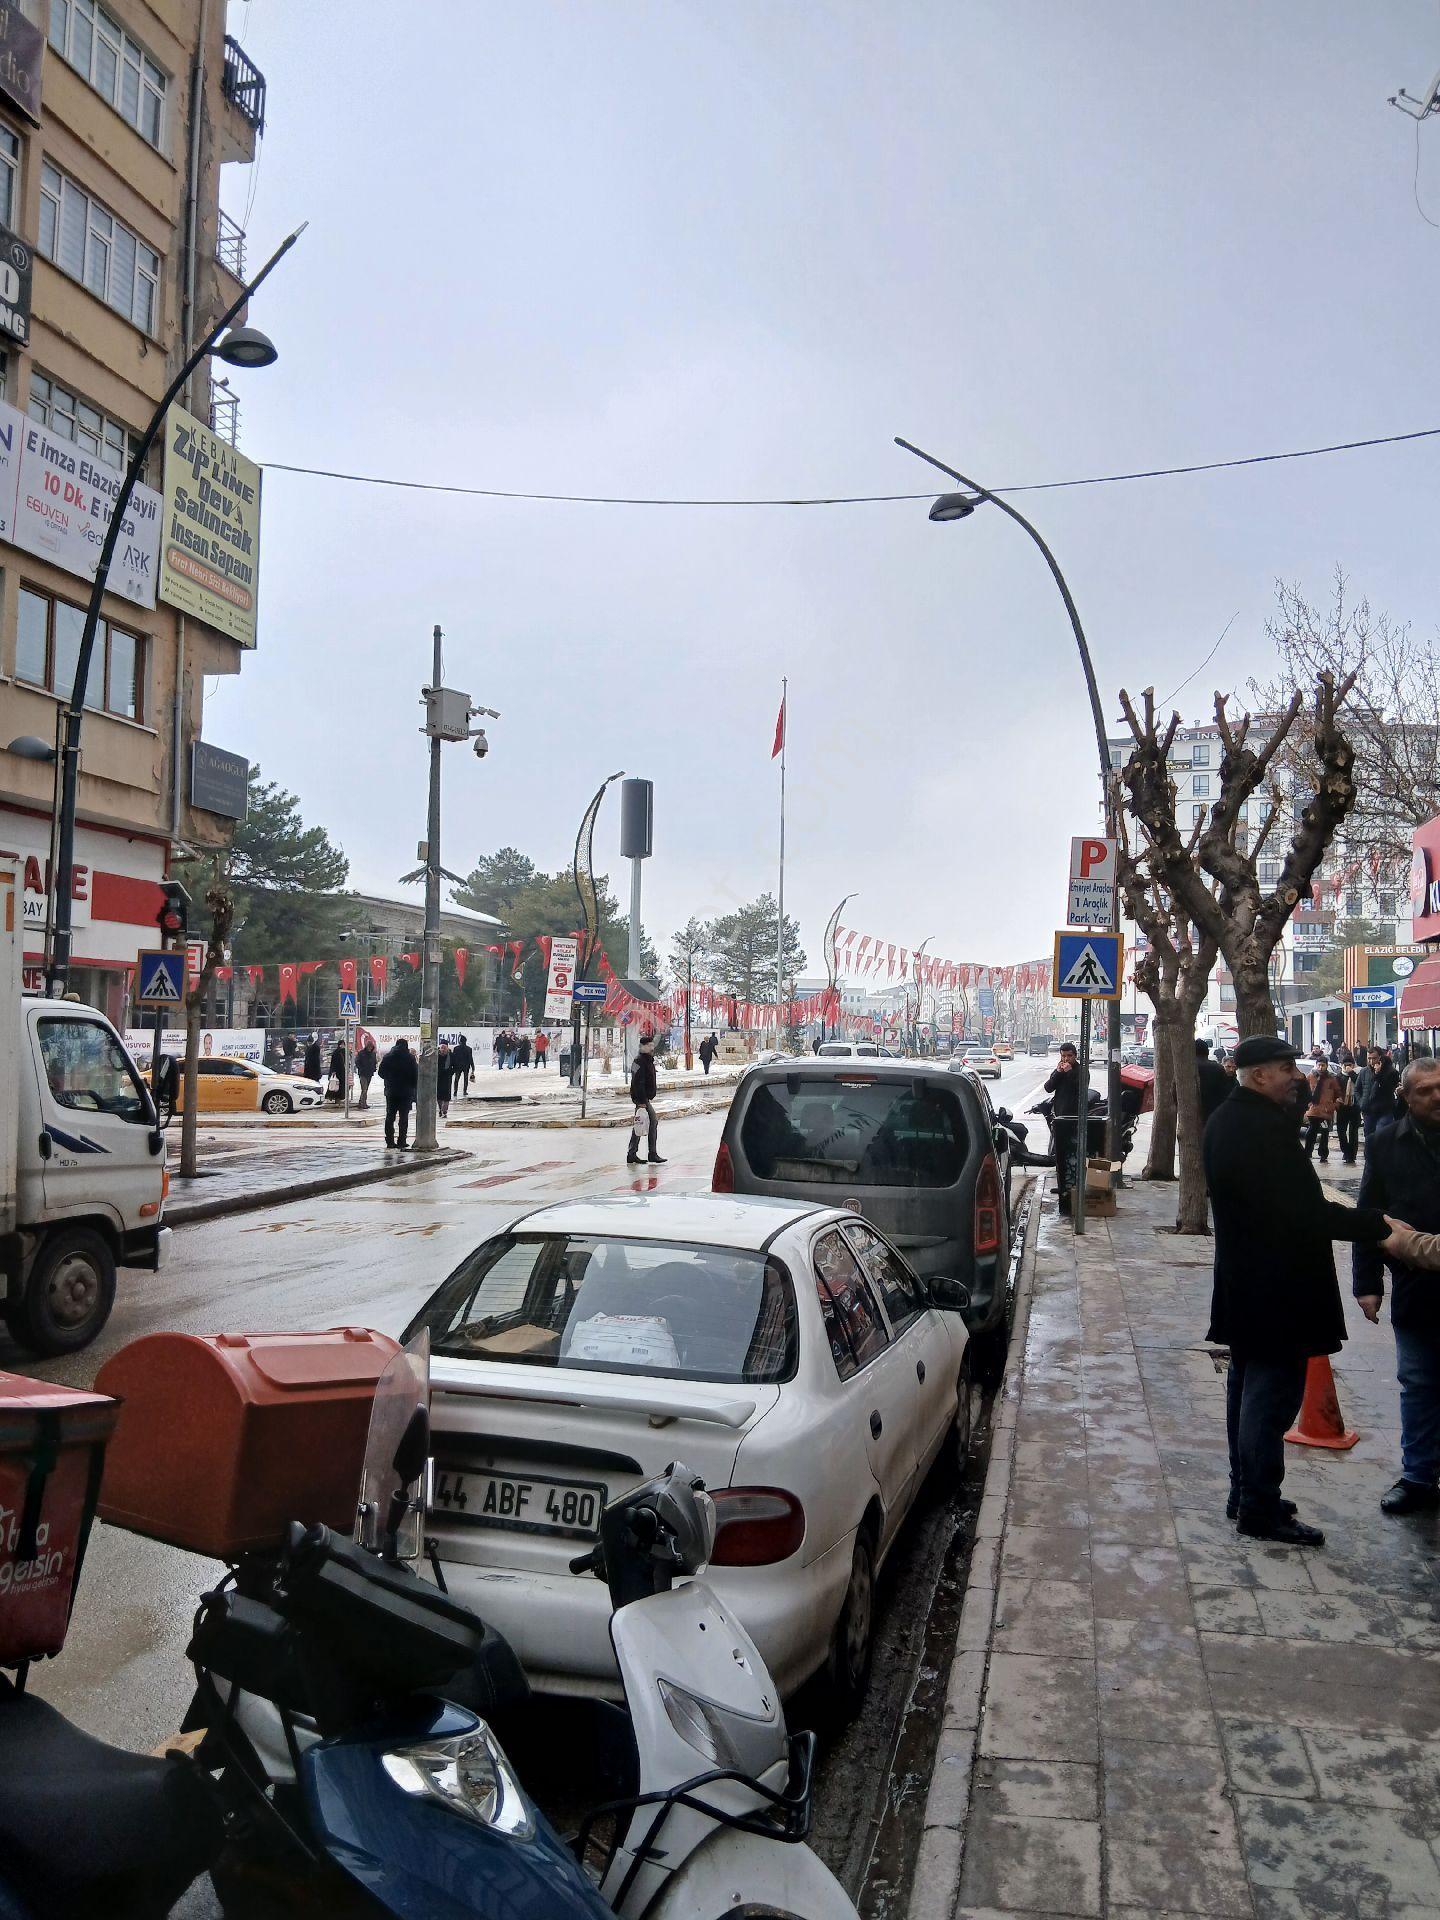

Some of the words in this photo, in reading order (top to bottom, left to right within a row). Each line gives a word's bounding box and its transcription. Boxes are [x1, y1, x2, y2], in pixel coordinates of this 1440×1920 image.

[40, 437, 76, 475] imza
[190, 425, 238, 475] KEBAN
[44, 470, 61, 496] 10
[64, 481, 87, 512] Dk.
[198, 476, 233, 517] Dev
[211, 461, 255, 505] LINE
[1080, 840, 1108, 878] P
[1070, 912, 1090, 923] Park
[1093, 913, 1111, 924] Yeri
[1075, 897, 1080, 907] 1
[1364, 943, 1394, 954] ELAZIĞ
[482, 1480, 533, 1518] ABF
[545, 1488, 596, 1528] 480
